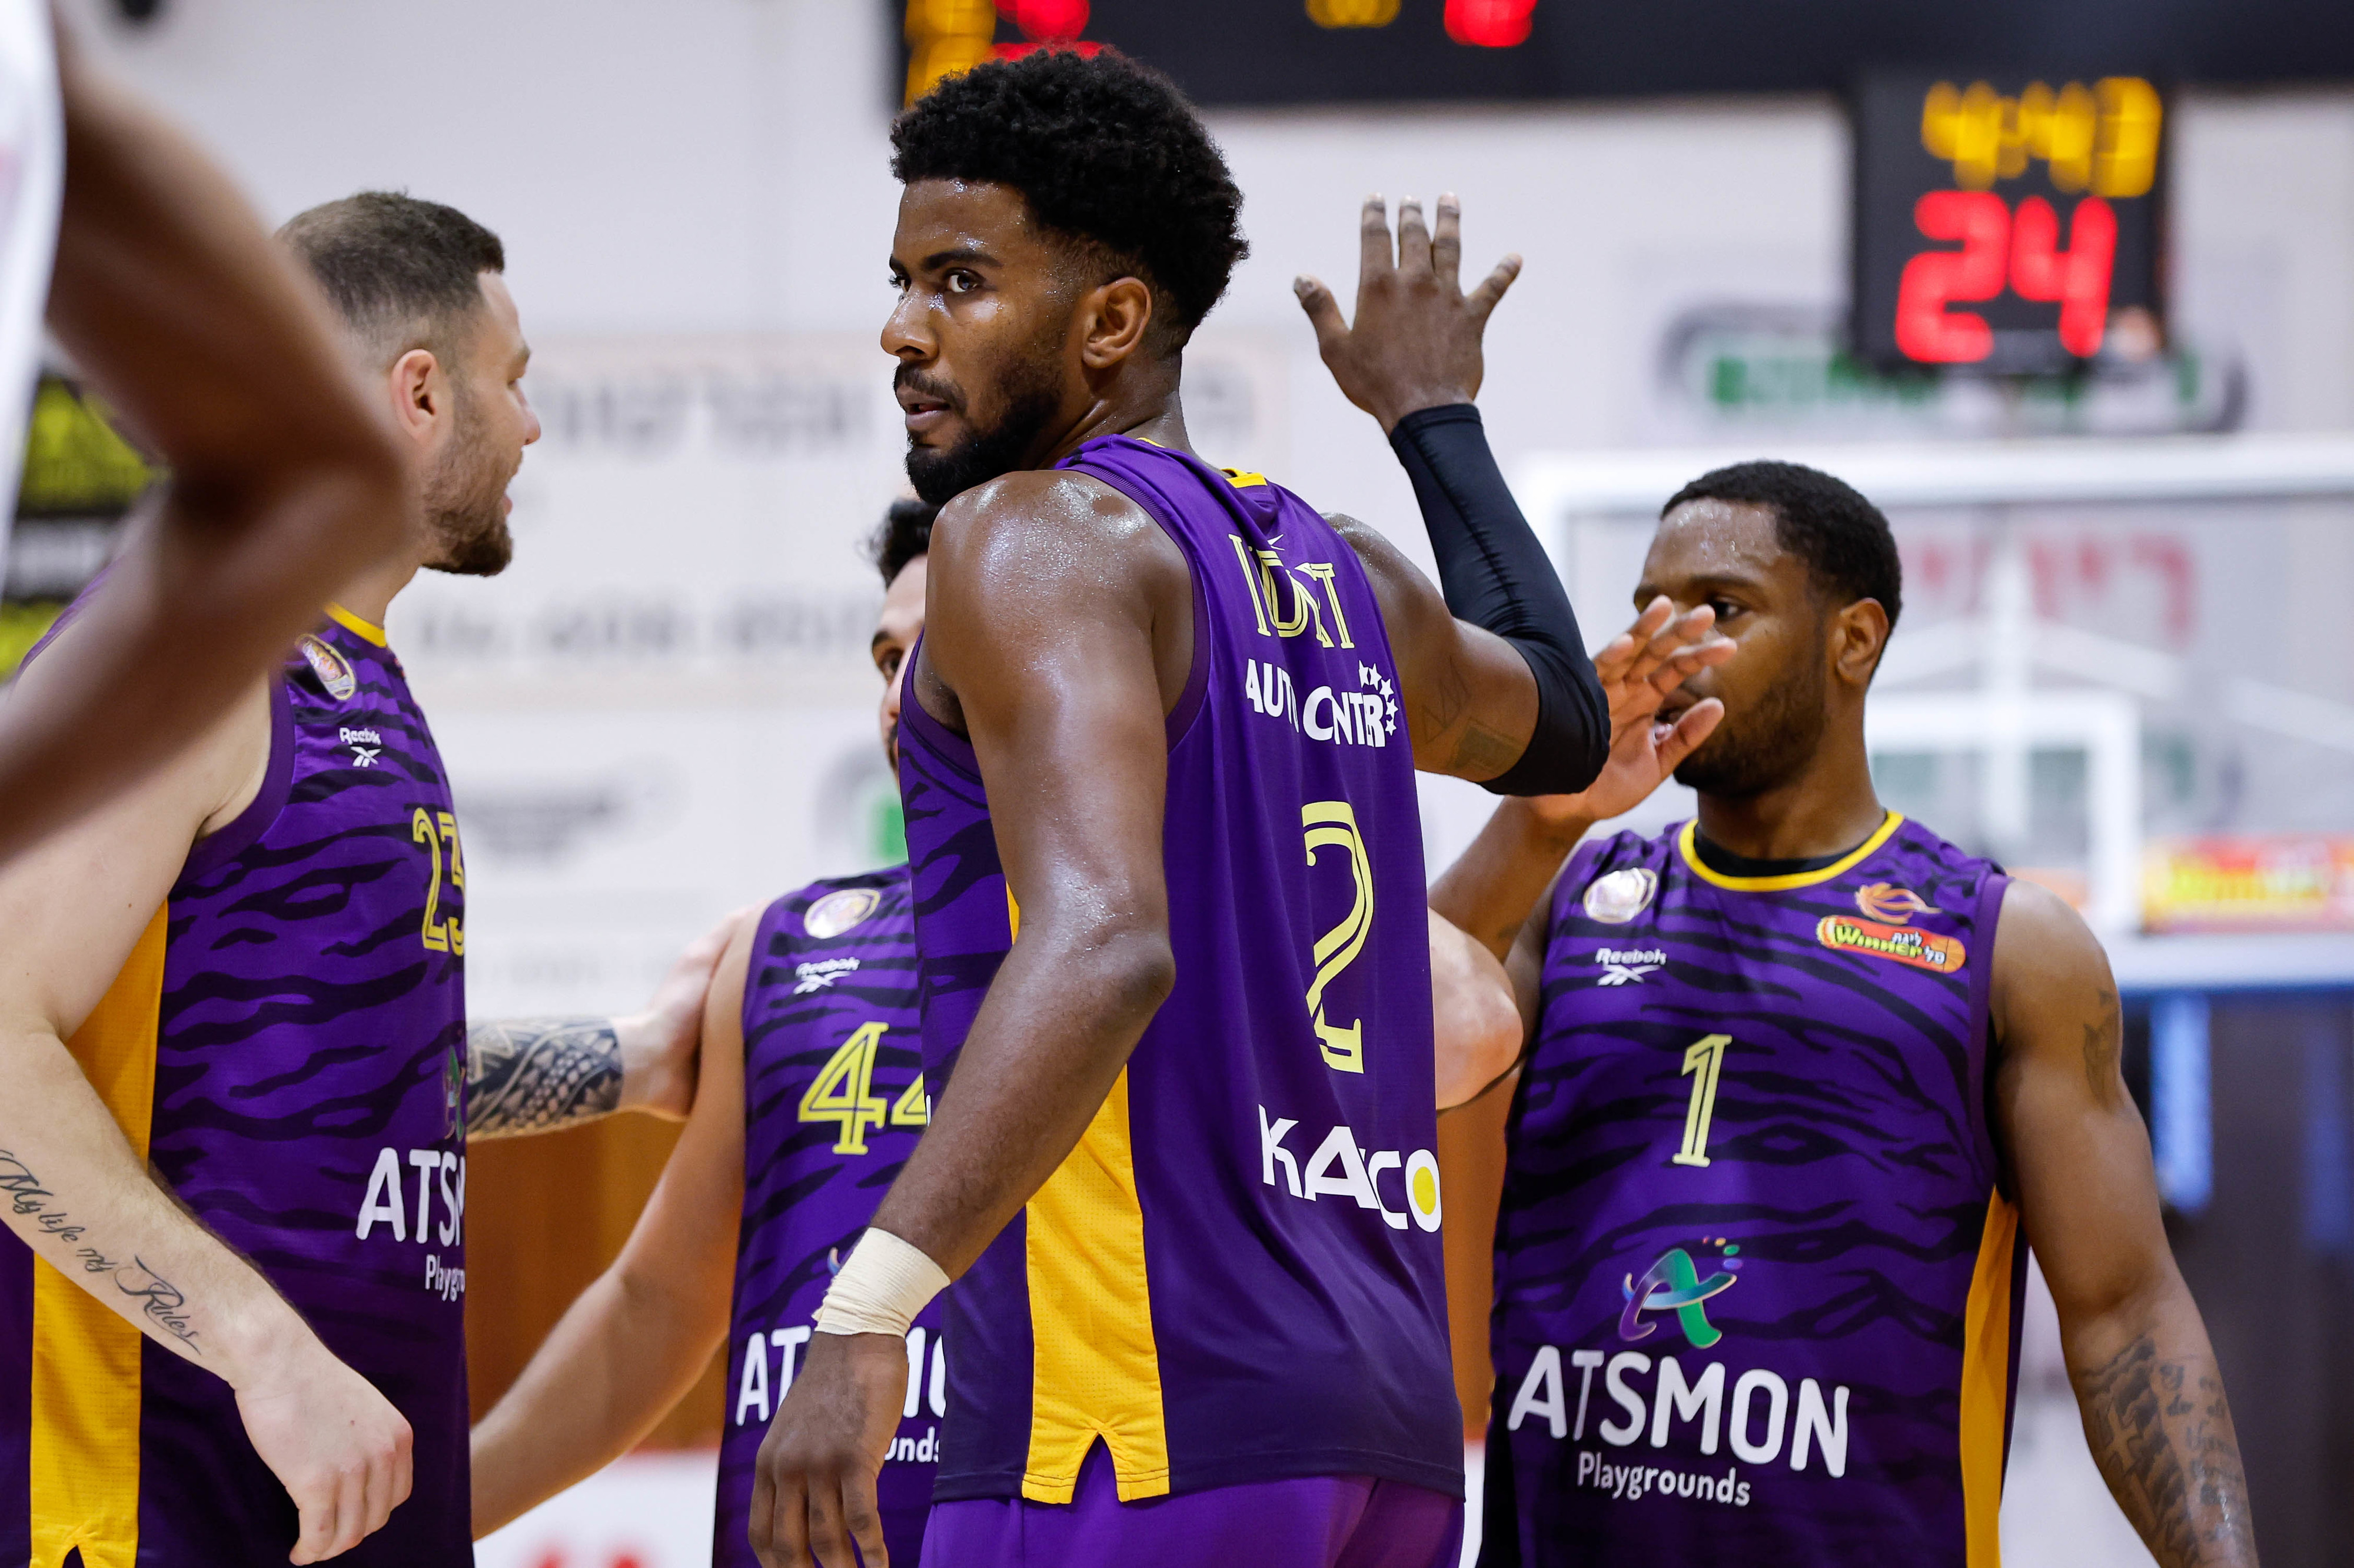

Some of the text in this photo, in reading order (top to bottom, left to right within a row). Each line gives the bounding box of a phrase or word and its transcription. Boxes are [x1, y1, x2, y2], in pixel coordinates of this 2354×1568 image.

[1896, 190, 2118, 363] 24
[413, 807, 465, 956] 23
[1302, 801, 1374, 1074] 2
[1834, 924, 1923, 958] Winner
[1595, 948, 1667, 965] Reebok
[1673, 1034, 1733, 1168] 1
[1258, 1104, 1442, 1233] KACO
[1507, 1345, 1850, 1479] ATSMON
[1577, 1451, 1751, 1507] Playgrounds
